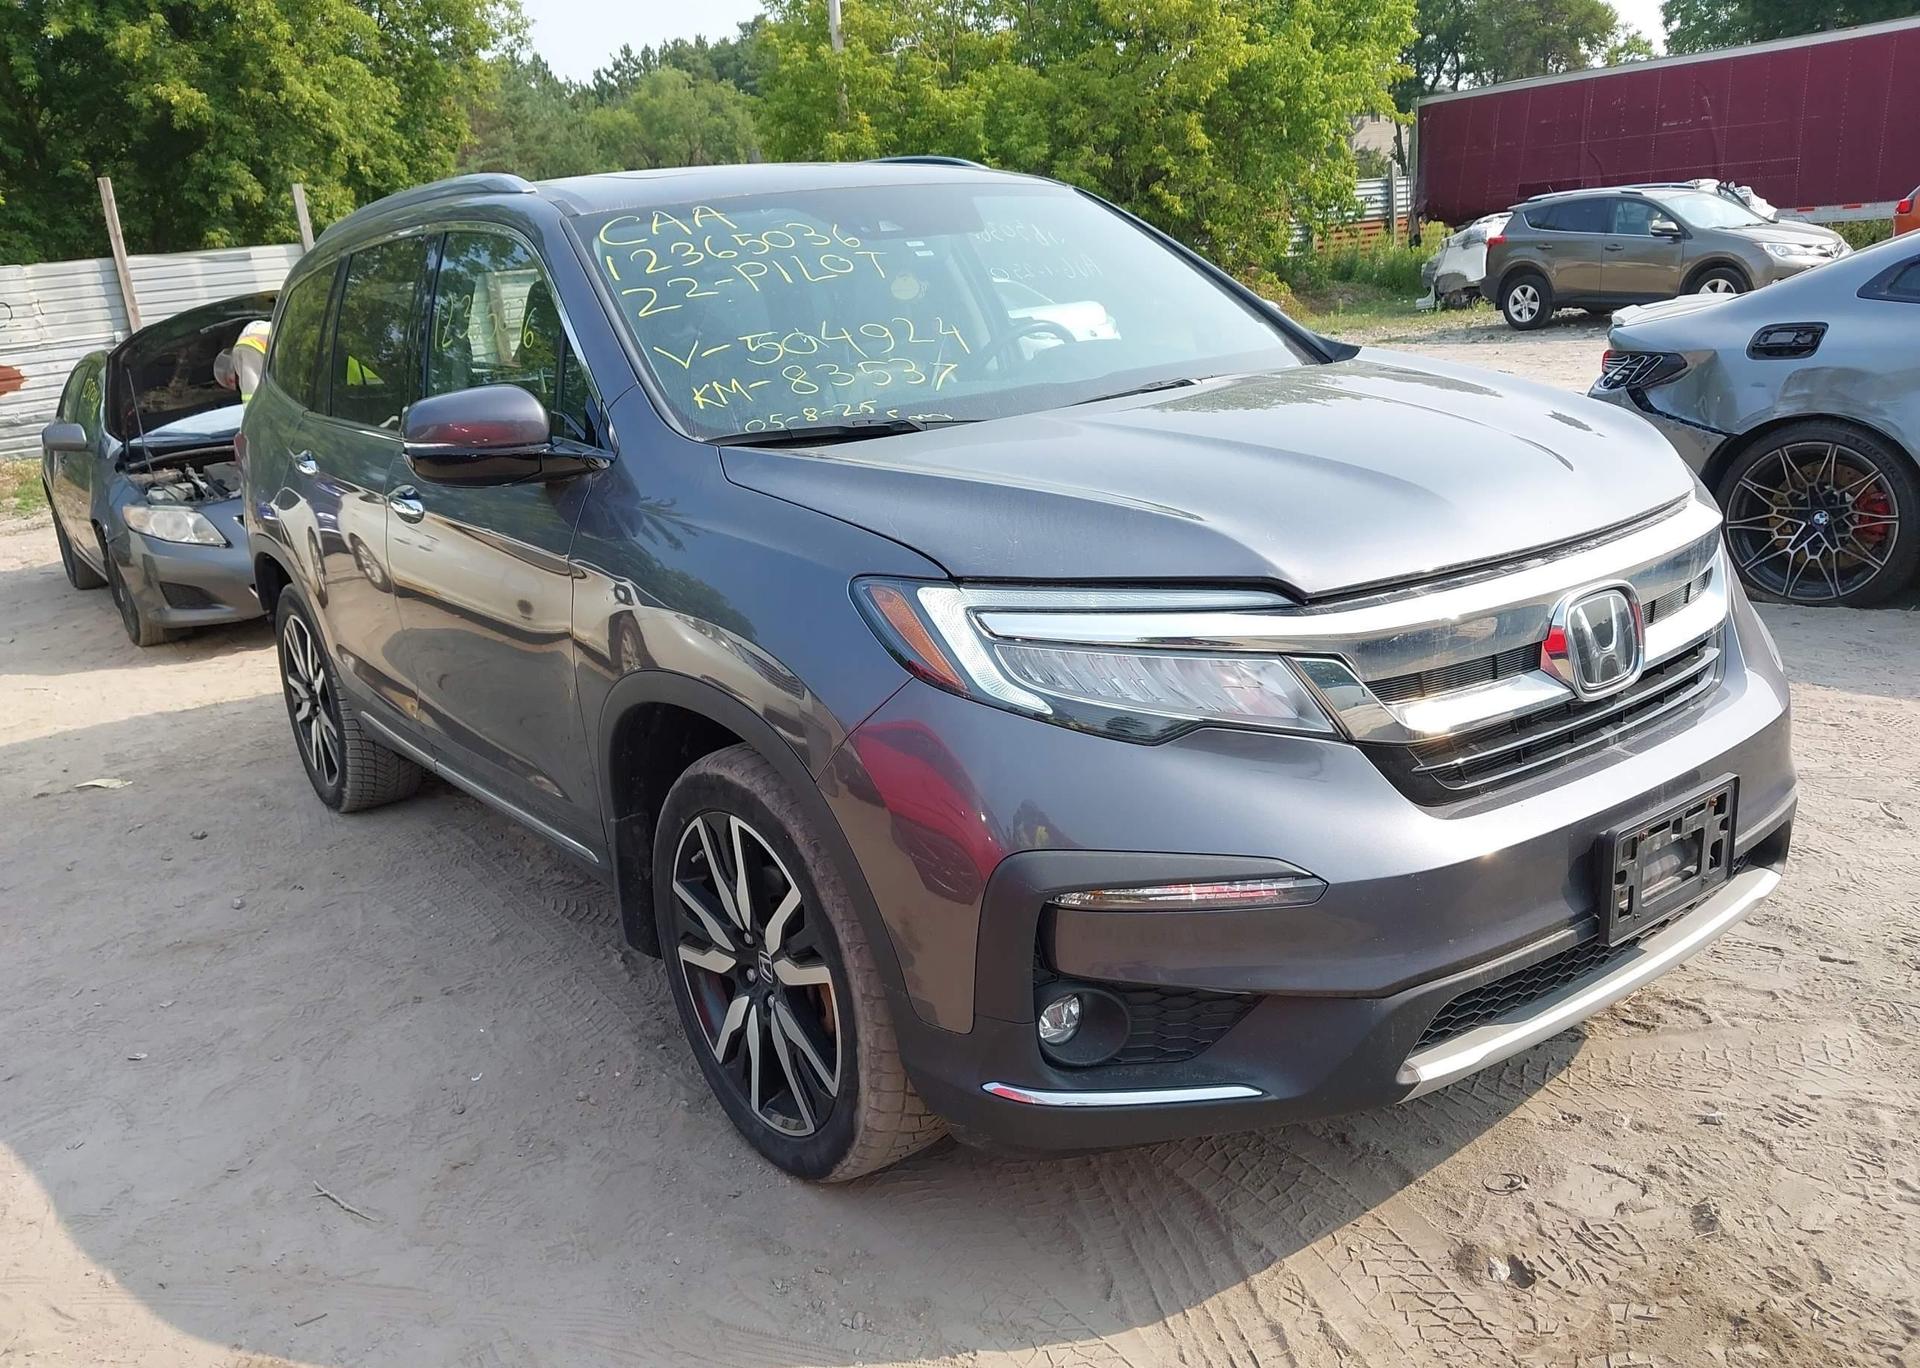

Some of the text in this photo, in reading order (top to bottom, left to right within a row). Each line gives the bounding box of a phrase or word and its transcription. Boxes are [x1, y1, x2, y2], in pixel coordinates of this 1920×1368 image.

[599, 206, 738, 246] CAA
[606, 223, 861, 281] 12365036
[621, 251, 888, 318] 22-PILOT
[653, 317, 971, 370] V-504924
[693, 358, 958, 410] KM-83537
